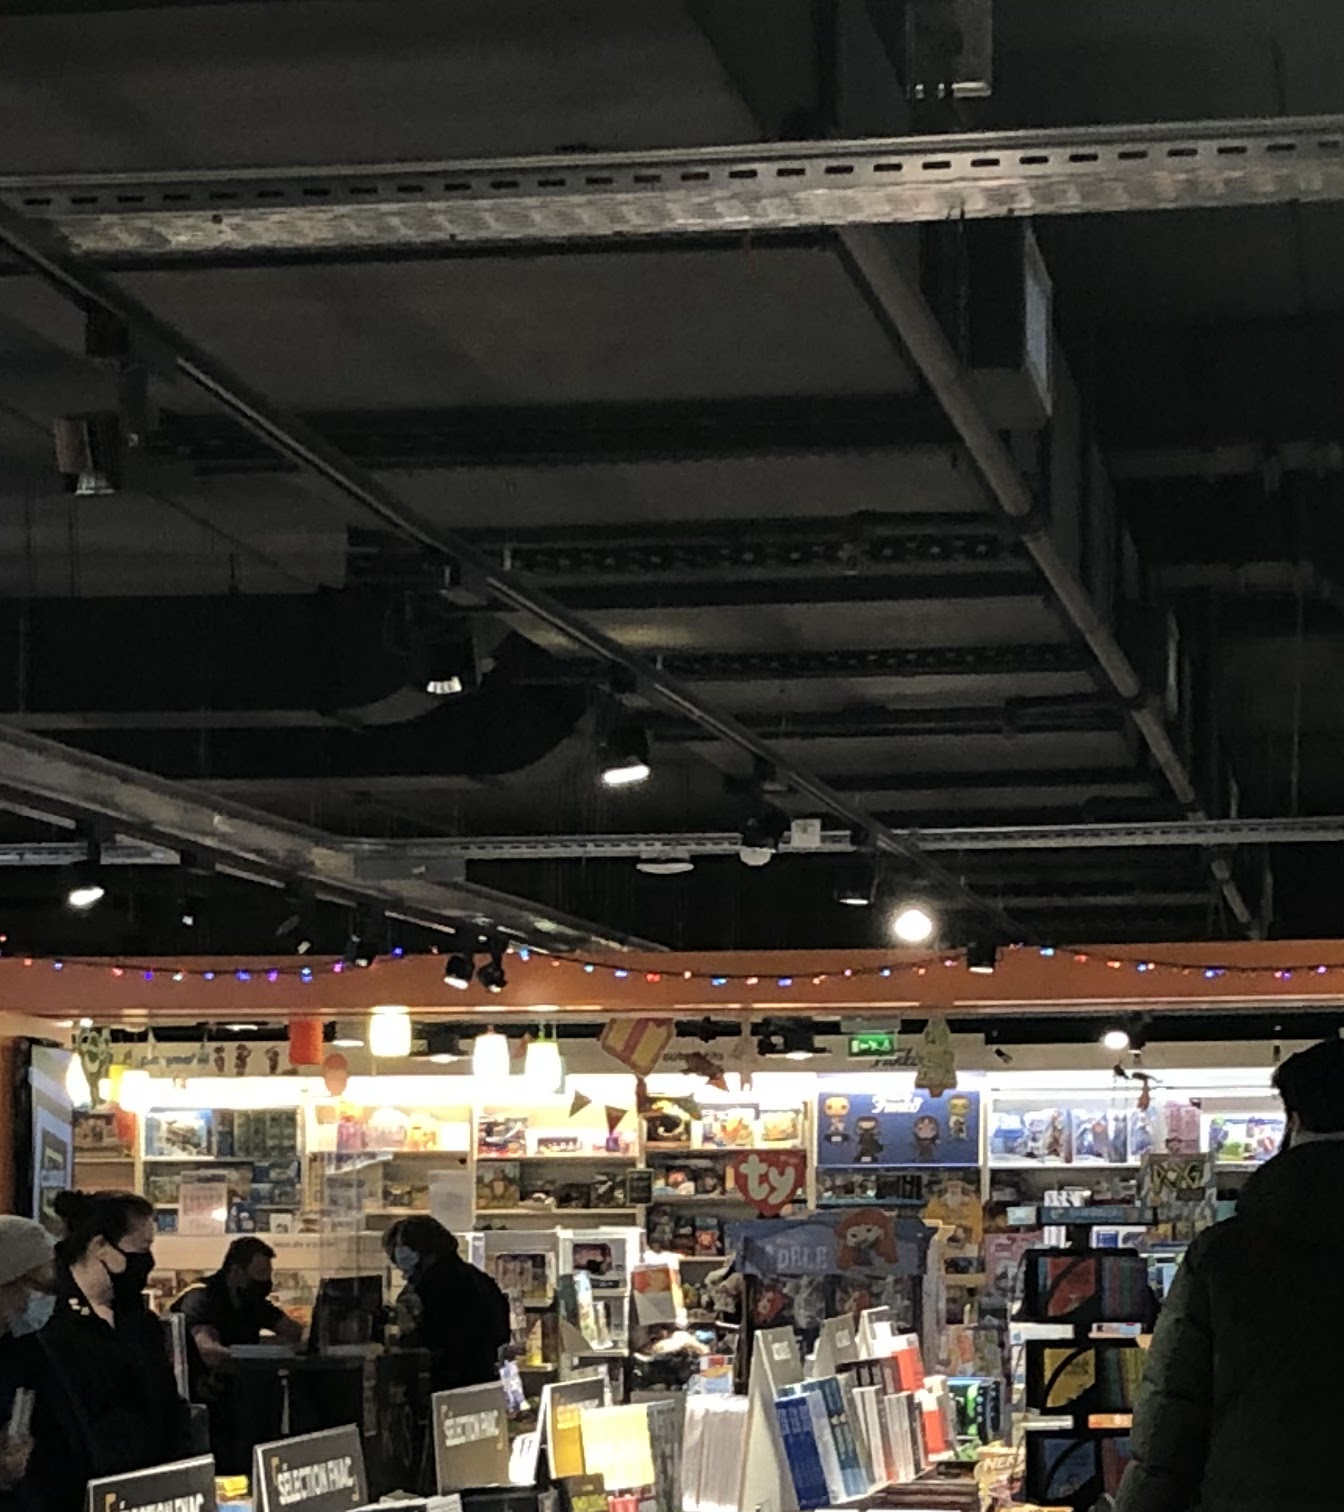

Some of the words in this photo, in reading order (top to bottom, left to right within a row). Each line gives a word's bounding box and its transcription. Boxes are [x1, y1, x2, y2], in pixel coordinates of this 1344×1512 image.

[739, 1156, 795, 1205] ty
[277, 1463, 327, 1505] SÉLECTION
[327, 1456, 354, 1488] FNAC
